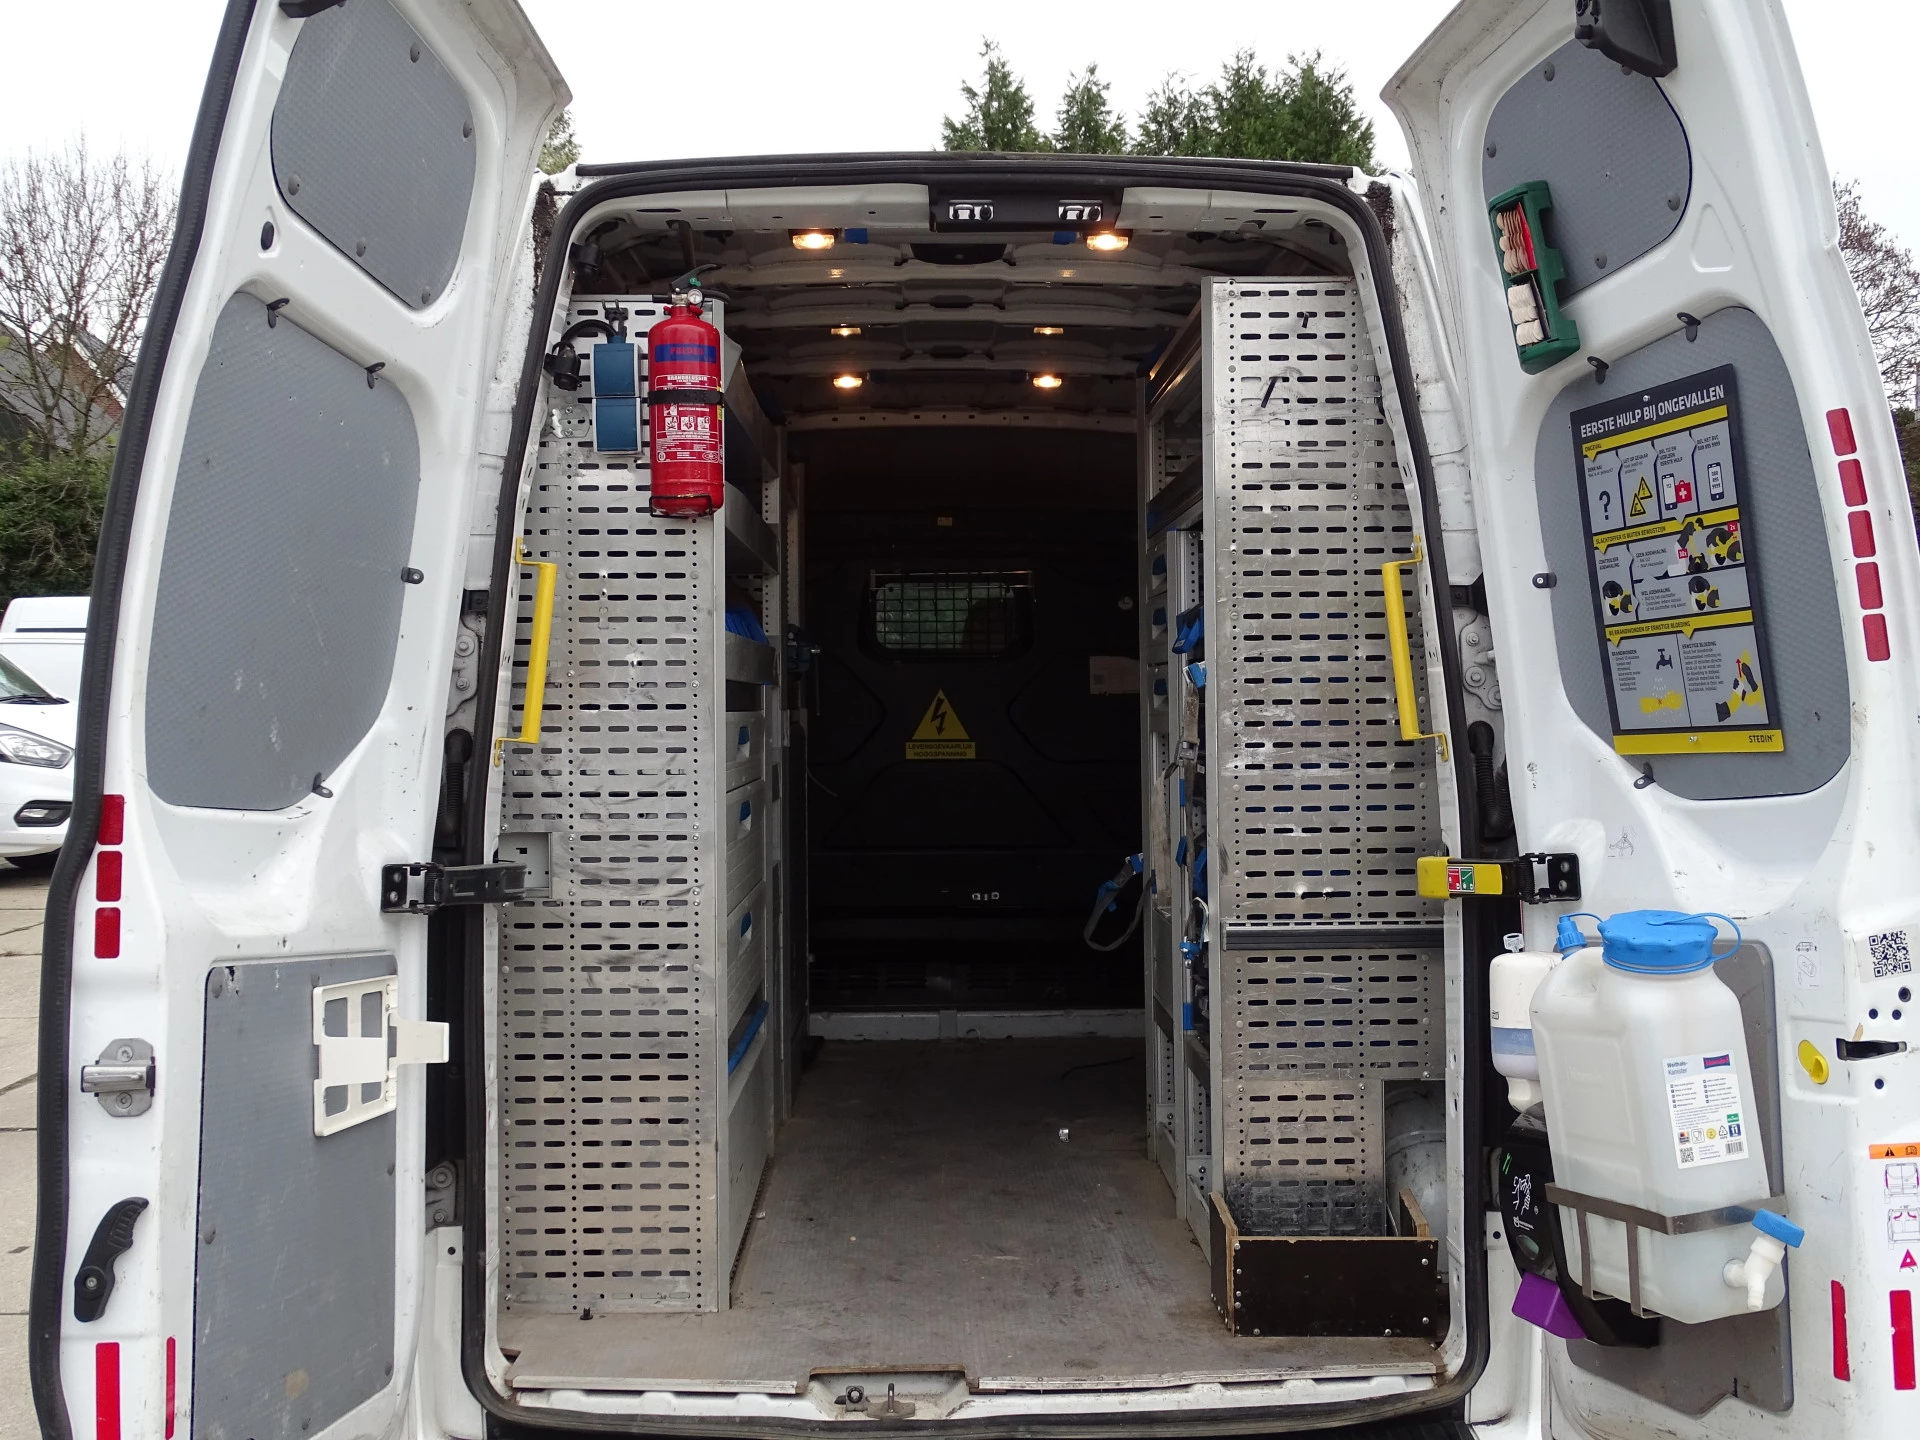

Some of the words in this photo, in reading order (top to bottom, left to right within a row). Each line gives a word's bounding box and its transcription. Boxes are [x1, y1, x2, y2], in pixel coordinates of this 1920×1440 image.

[1580, 418, 1614, 438] EERSTE
[1616, 409, 1642, 428] HULP
[1643, 404, 1656, 421] BIJ
[1658, 384, 1724, 416] ONGEVALLEN
[1585, 444, 1602, 452] ONGEVAL
[1641, 526, 1666, 536] BEWUSTZIJN
[1679, 550, 1688, 558] 30x
[1614, 627, 1644, 635] BRANDWONDEN
